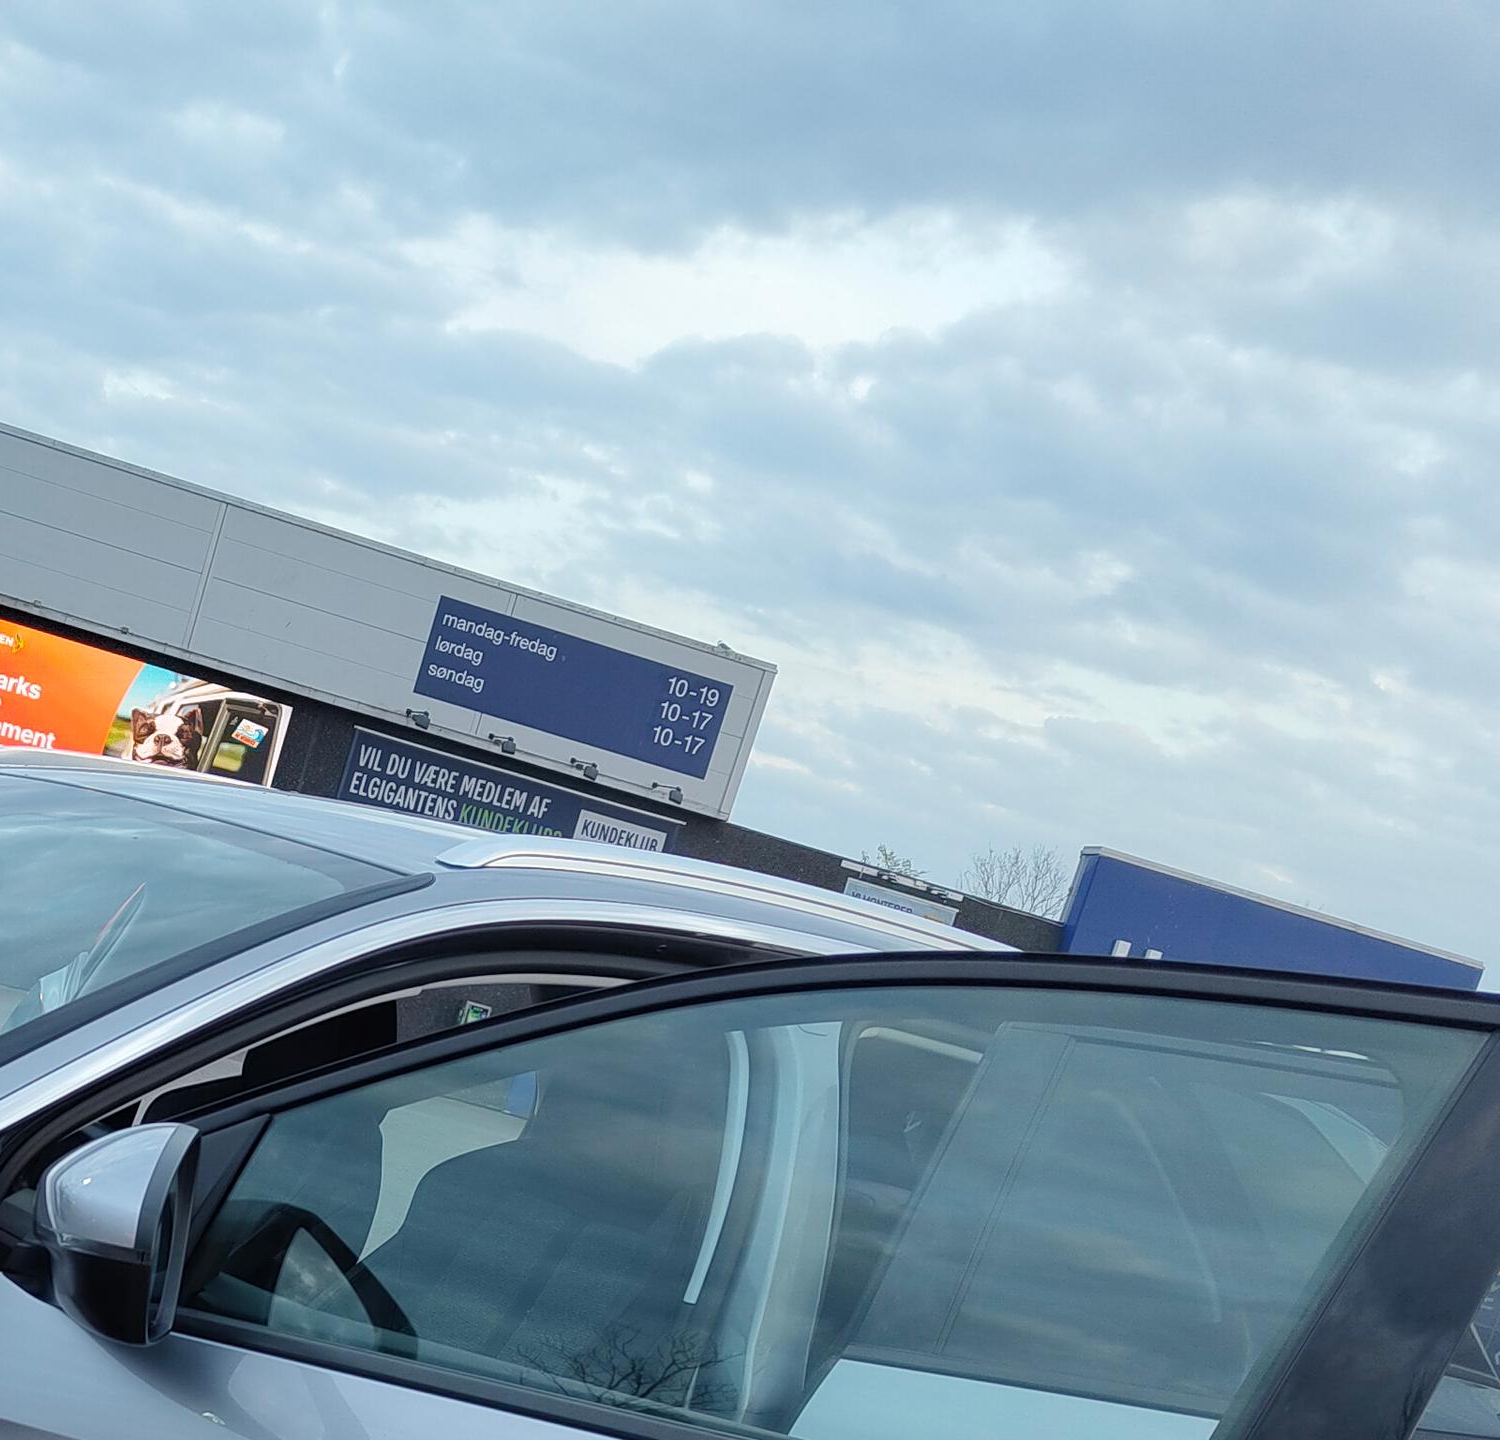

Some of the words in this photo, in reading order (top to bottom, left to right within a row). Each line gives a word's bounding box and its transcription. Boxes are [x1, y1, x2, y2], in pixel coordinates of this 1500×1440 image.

[435, 635, 484, 666] lørdag
[442, 613, 558, 661] mandag-fredag
[427, 663, 485, 693] søndag
[668, 676, 720, 707] 10-19
[661, 701, 713, 730] 10-17
[653, 725, 706, 755] 10-17
[349, 771, 458, 821] ELGIGANTENS
[358, 744, 383, 773] VIL
[386, 753, 409, 779] DU
[413, 759, 460, 793] VÆRE
[458, 773, 531, 813] MEDLEM
[527, 796, 552, 819] AF
